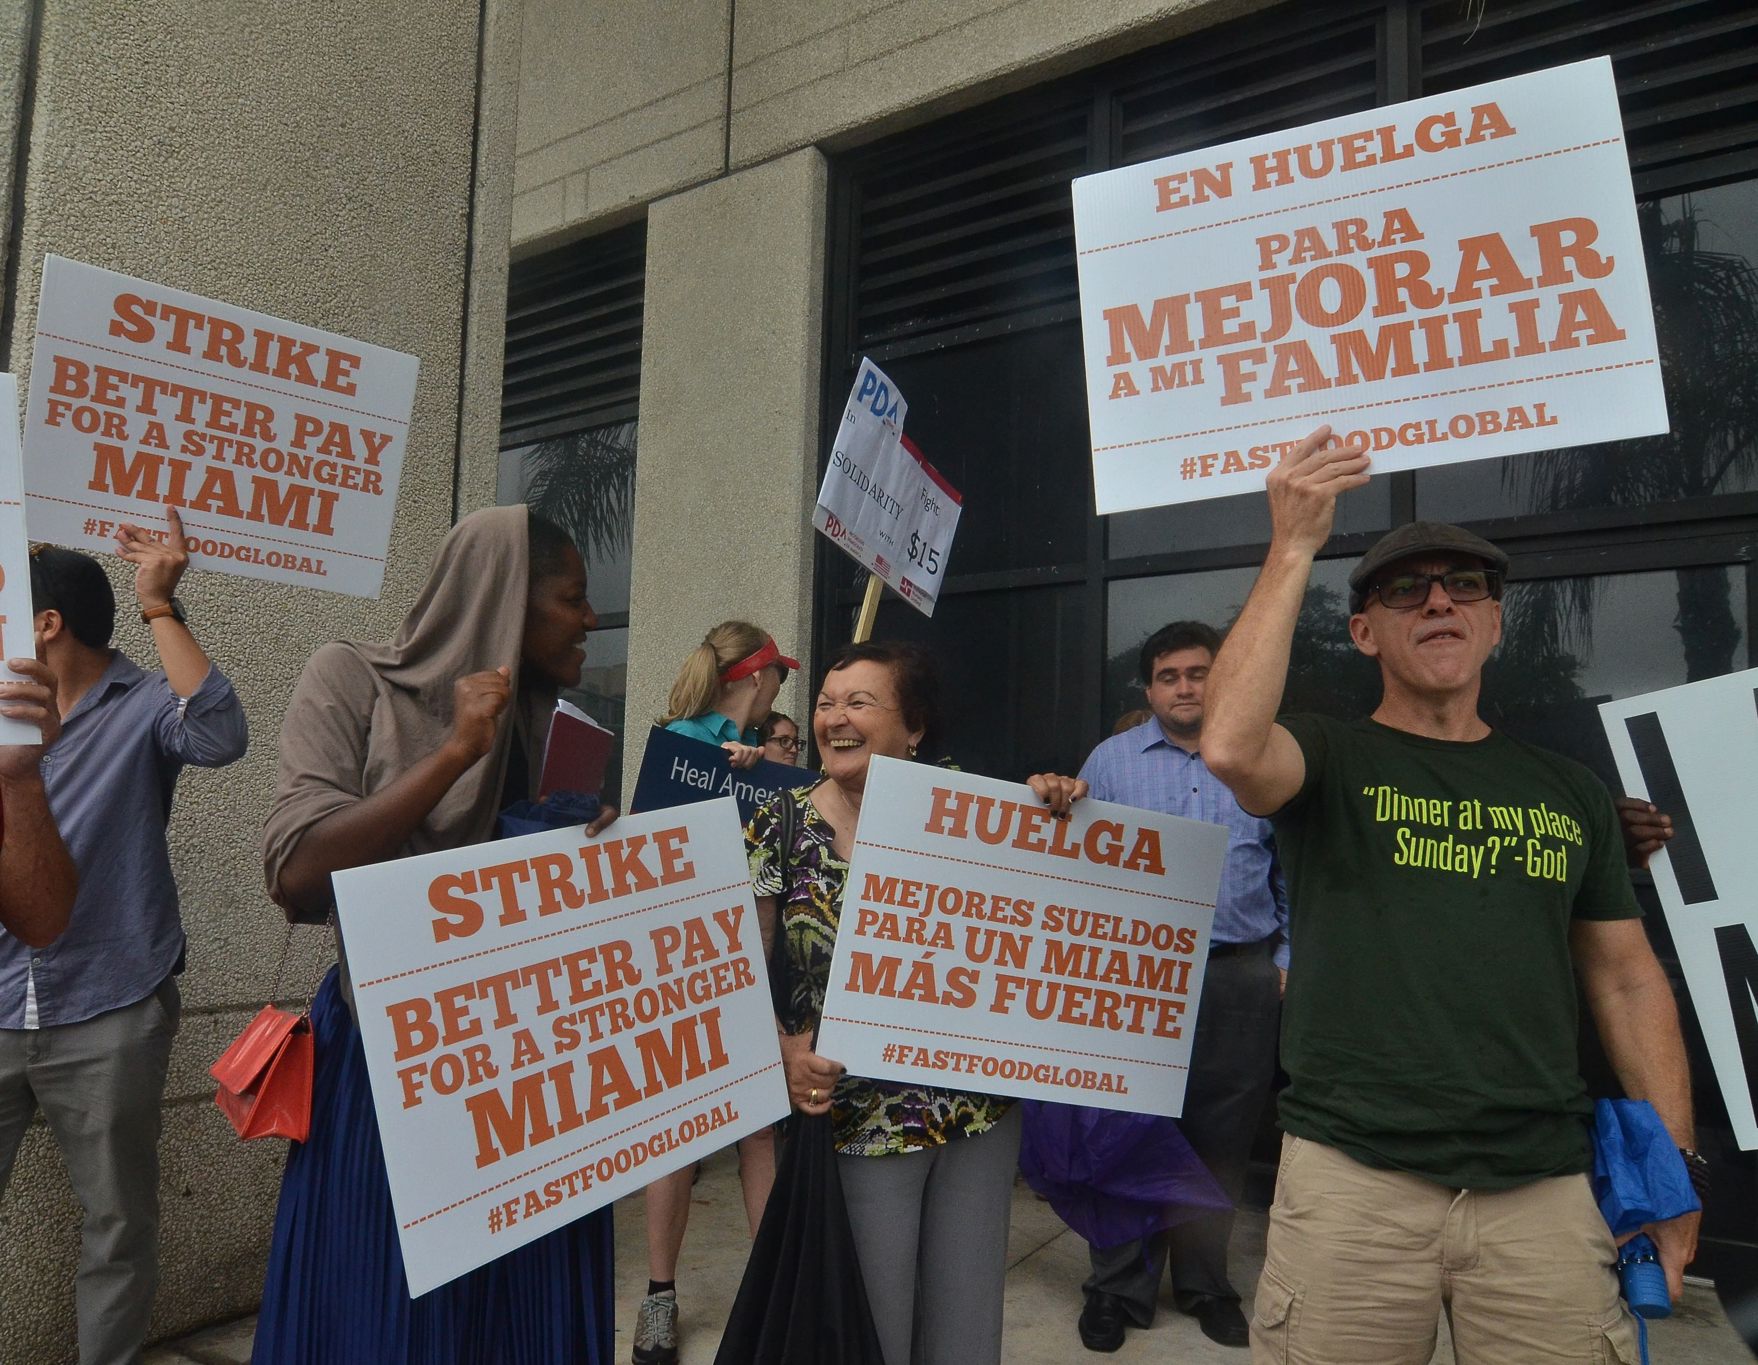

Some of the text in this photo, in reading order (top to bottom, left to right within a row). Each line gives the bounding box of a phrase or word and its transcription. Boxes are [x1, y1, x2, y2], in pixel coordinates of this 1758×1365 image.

[1153, 101, 1517, 213] EN HUELGA
[1255, 207, 1425, 272] PARA
[1102, 216, 1615, 367] MEJORAR
[108, 292, 362, 397] STRIKE
[1108, 287, 1627, 407] A MI FAMILIA
[44, 397, 384, 495] FOR A STRONGER
[48, 355, 393, 468] BETTER PAY
[1179, 402, 1559, 481] #FASTOODGLOBAL
[87, 441, 340, 537] MIAMI
[832, 450, 904, 521] SOLIDARITY
[920, 487, 941, 517] Fight
[906, 528, 940, 576] $15
[670, 756, 717, 791] Heal
[1362, 785, 1583, 846] “Dinner at my place
[923, 786, 1166, 876] HUELGA
[427, 826, 696, 943] STRIKE
[860, 873, 1197, 955] MEJORES SUELDOS
[385, 904, 746, 1063] BETTER PAY
[844, 951, 1187, 1040] MÁS FUERTE
[854, 908, 1193, 996] PARA UN MIAMI
[397, 956, 756, 1110] FOR A STRONGER
[881, 1042, 1129, 1095] #FASTFOODGLOBAL
[464, 1006, 730, 1170] MIAMI
[487, 1101, 740, 1235] #FASTFOODGLOBAL
